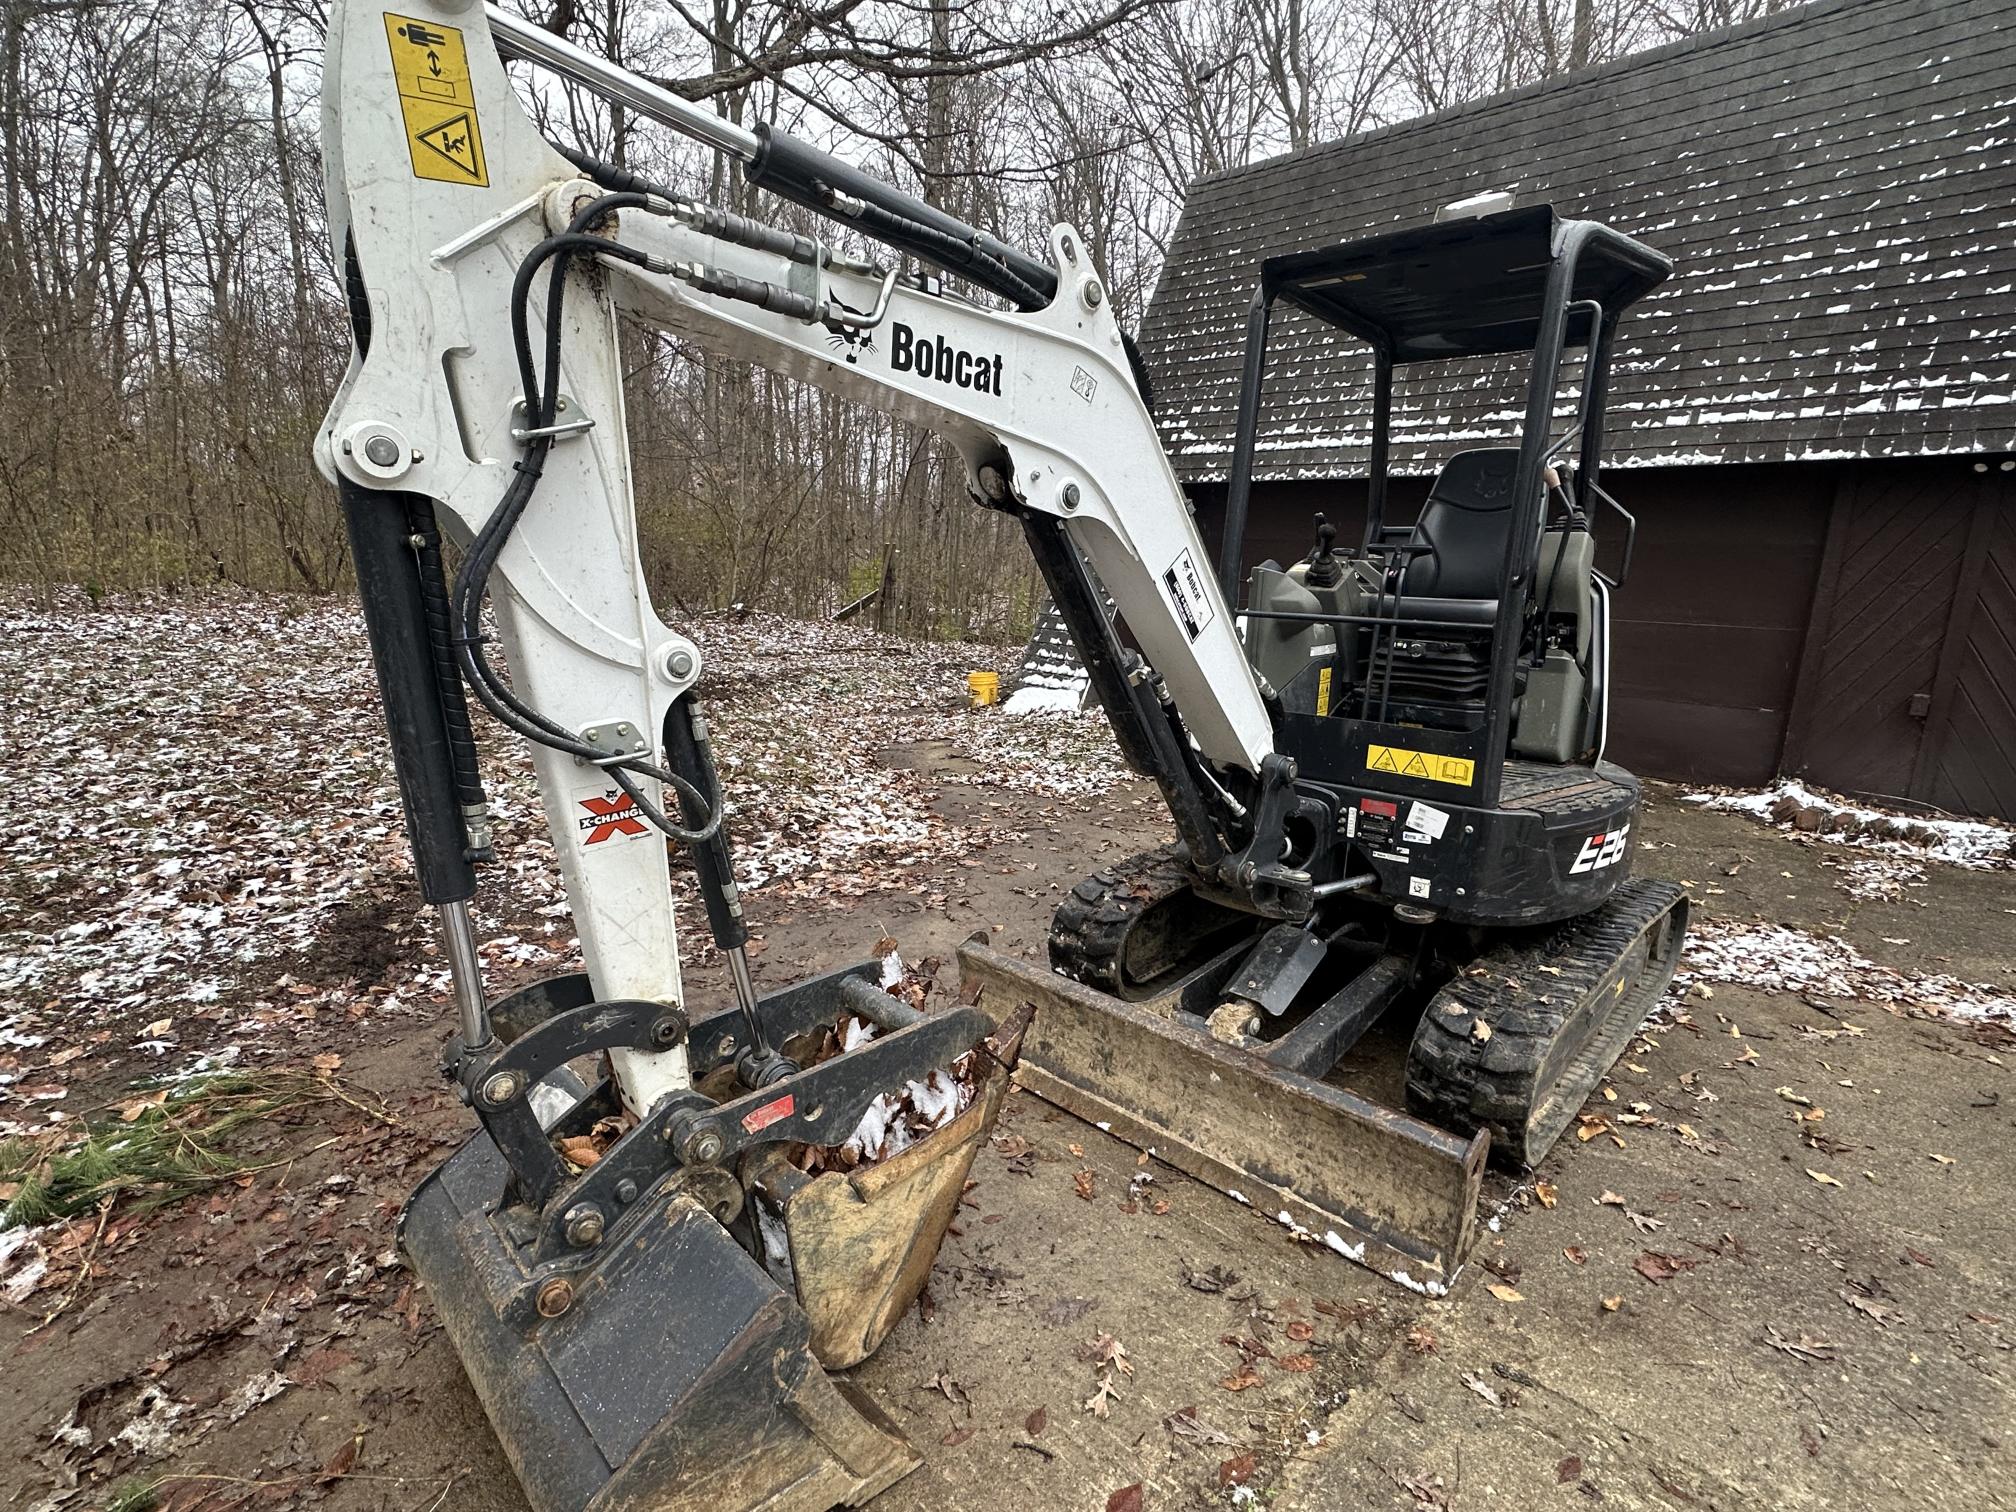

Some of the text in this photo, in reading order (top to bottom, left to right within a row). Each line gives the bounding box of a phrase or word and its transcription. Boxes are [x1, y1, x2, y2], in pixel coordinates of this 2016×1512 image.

[891, 321, 1003, 397] Bobcat
[1186, 572, 1201, 601] Bobcat
[1568, 823, 1631, 875] E26
